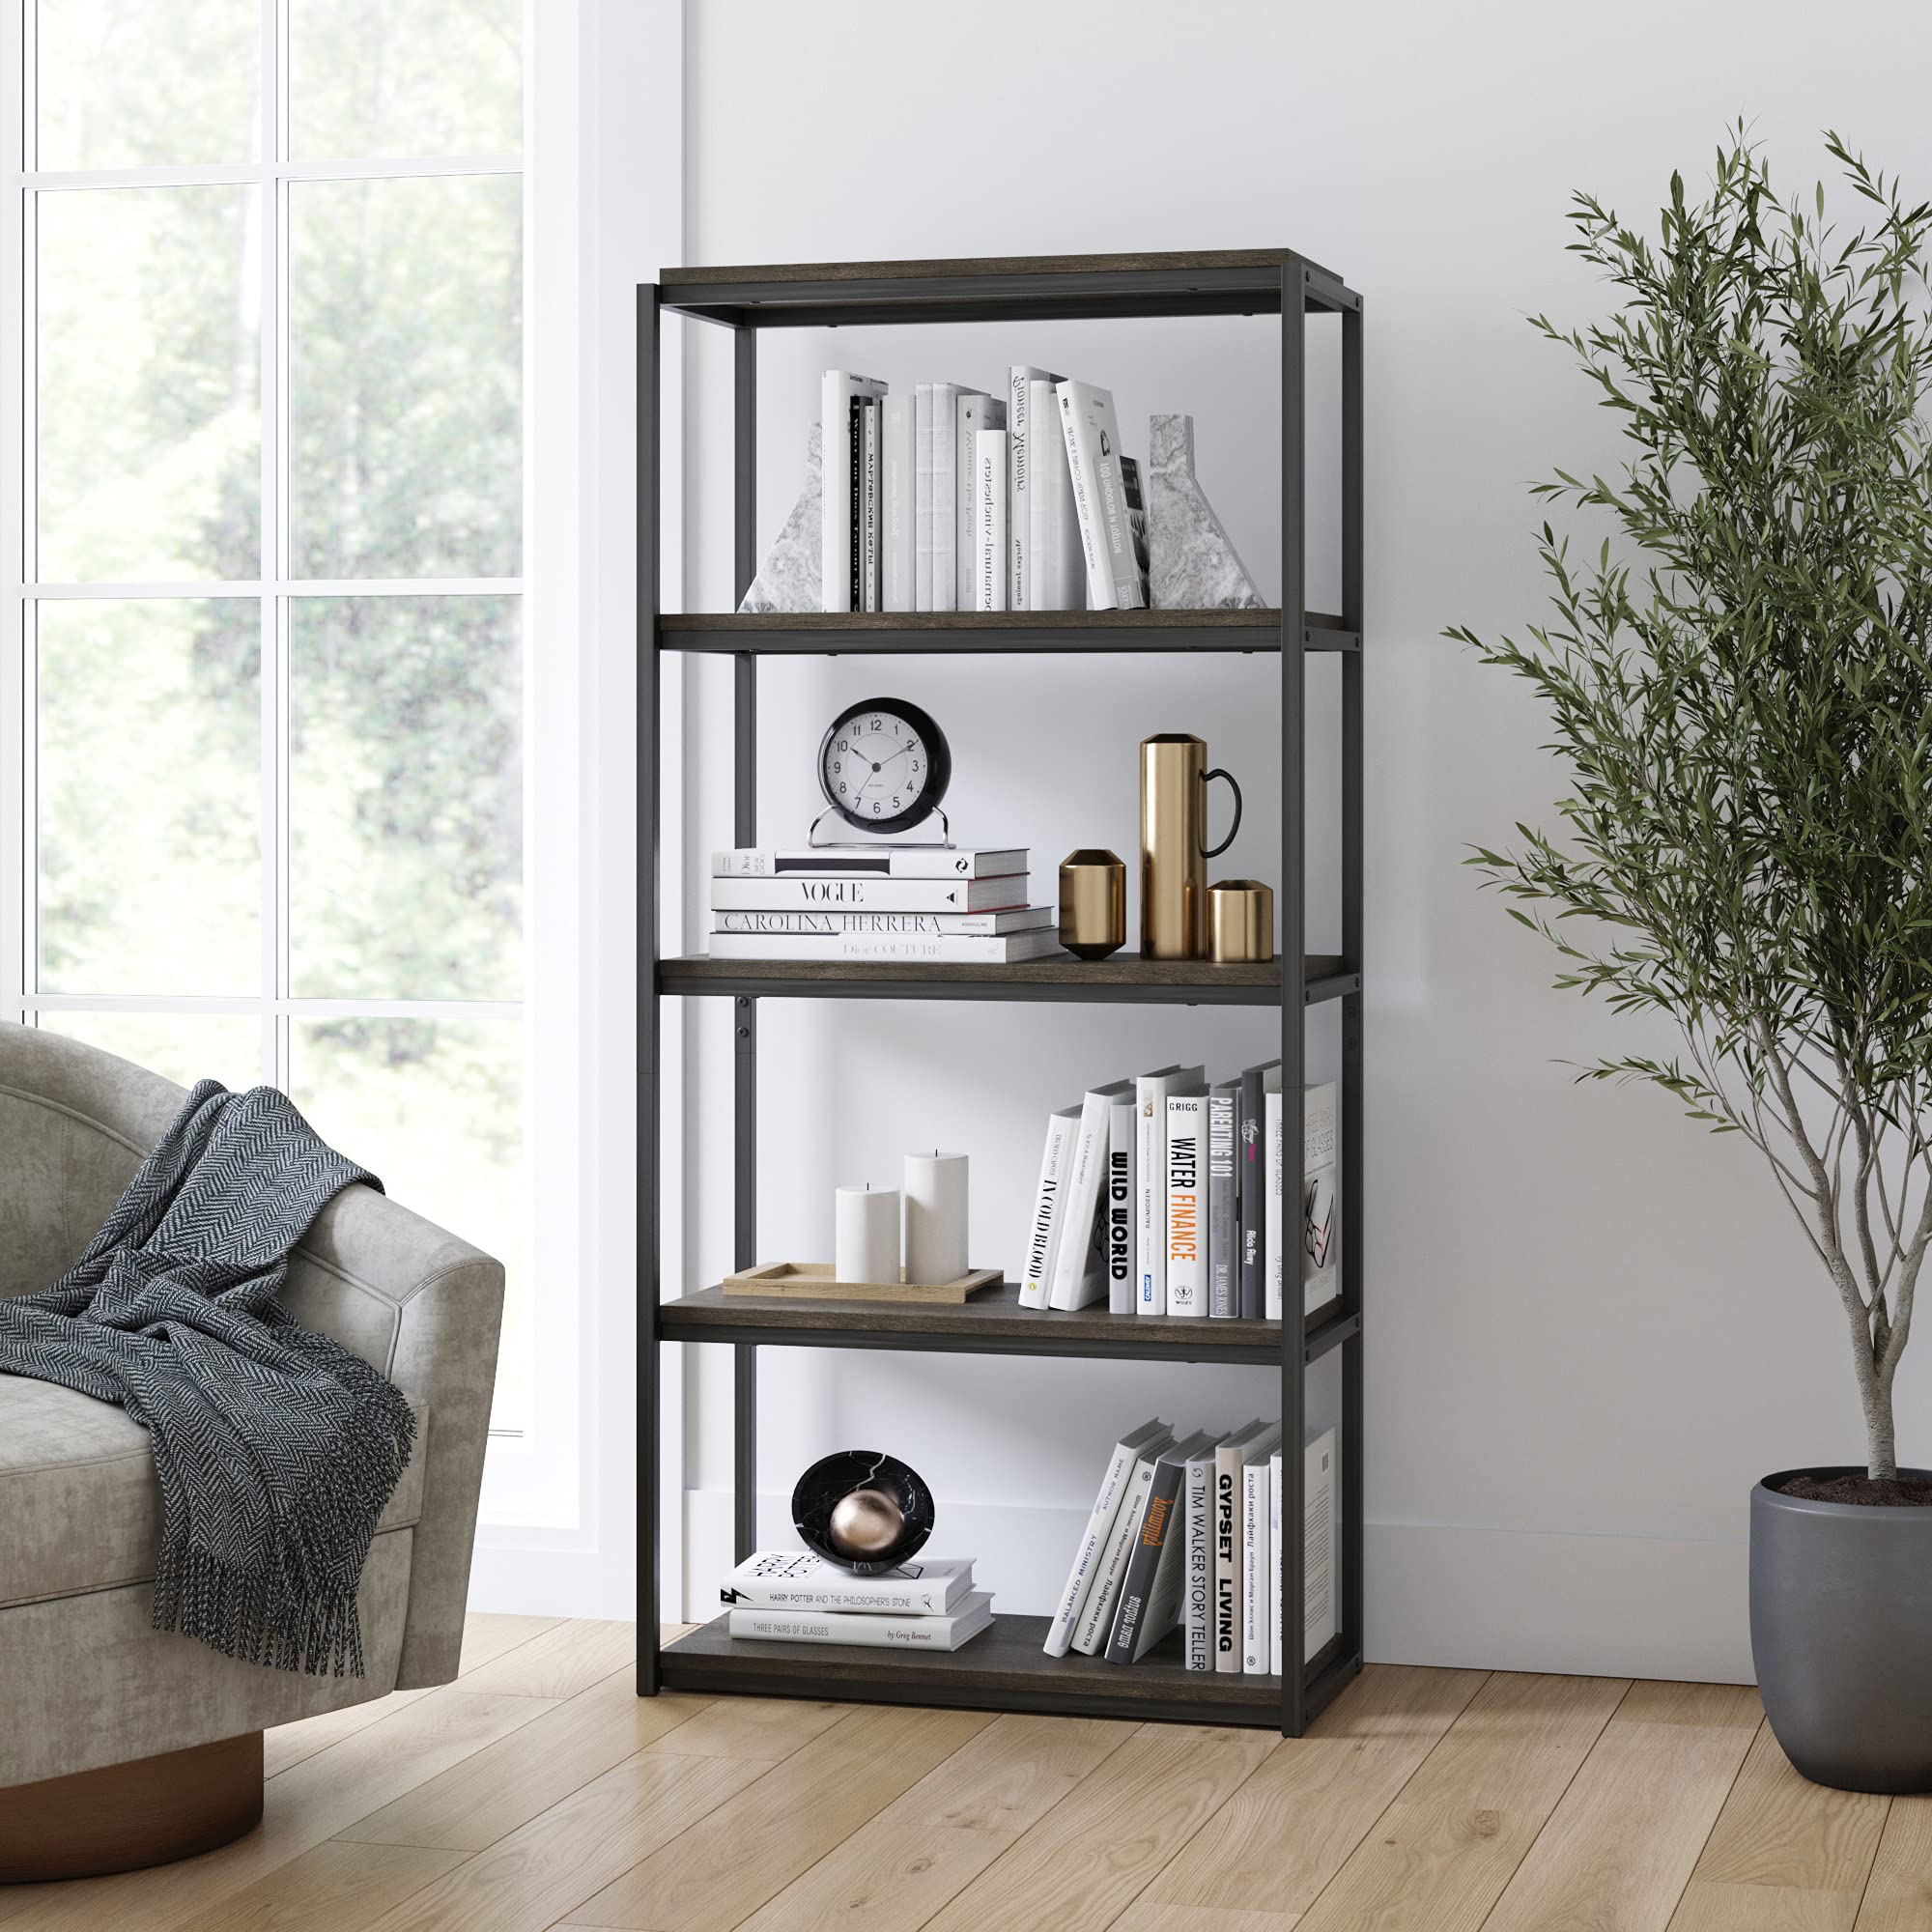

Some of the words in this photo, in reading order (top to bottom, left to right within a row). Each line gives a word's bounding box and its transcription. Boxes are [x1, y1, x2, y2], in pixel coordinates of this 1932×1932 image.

[854, 725, 861, 735] 11
[870, 720, 881, 730] 12
[838, 741, 847, 752] 10
[906, 740, 914, 752] 2
[835, 762, 840, 773] 9
[912, 760, 919, 772] 3
[839, 781, 846, 793] 8
[907, 781, 914, 792] 4
[855, 797, 861, 809] 7
[873, 803, 880, 813] 6
[893, 797, 899, 808] 5
[801, 882, 864, 902] VOGUE
[724, 914, 834, 932] CAROLINA
[842, 914, 942, 932] HERRERA
[1169, 1102, 1198, 1112] GRIGG
[1210, 1097, 1233, 1156] PARENTING
[1171, 1137, 1196, 1188] WATER
[1210, 1159, 1233, 1178] 101
[1111, 1151, 1128, 1201] WILD
[1042, 1179, 1057, 1194] IN
[1037, 1196, 1054, 1233] COLD
[1171, 1195, 1197, 1261] FINANCE
[1111, 1208, 1128, 1280] WORLD
[1029, 1234, 1047, 1278] BLOOD
[1214, 1275, 1228, 1296] JAMES
[1214, 1296, 1229, 1316] JONES
[1191, 1486, 1206, 1509] TIM
[1219, 1474, 1232, 1562] GYPSET
[1191, 1514, 1206, 1571] WALKER
[1078, 1534, 1097, 1577] MINISTRY
[790, 1594, 813, 1603] POTTER
[893, 1598, 910, 1606] STONE
[1191, 1576, 1206, 1620] STORY
[1219, 1578, 1232, 1652] LIVING
[753, 1623, 771, 1633] THREE
[774, 1624, 790, 1634] PAIRS
[793, 1625, 800, 1634] OF
[802, 1626, 829, 1636] GLASSES
[887, 1631, 895, 1639] by
[896, 1631, 910, 1641] Greg
[1191, 1625, 1206, 1670] TELLER
